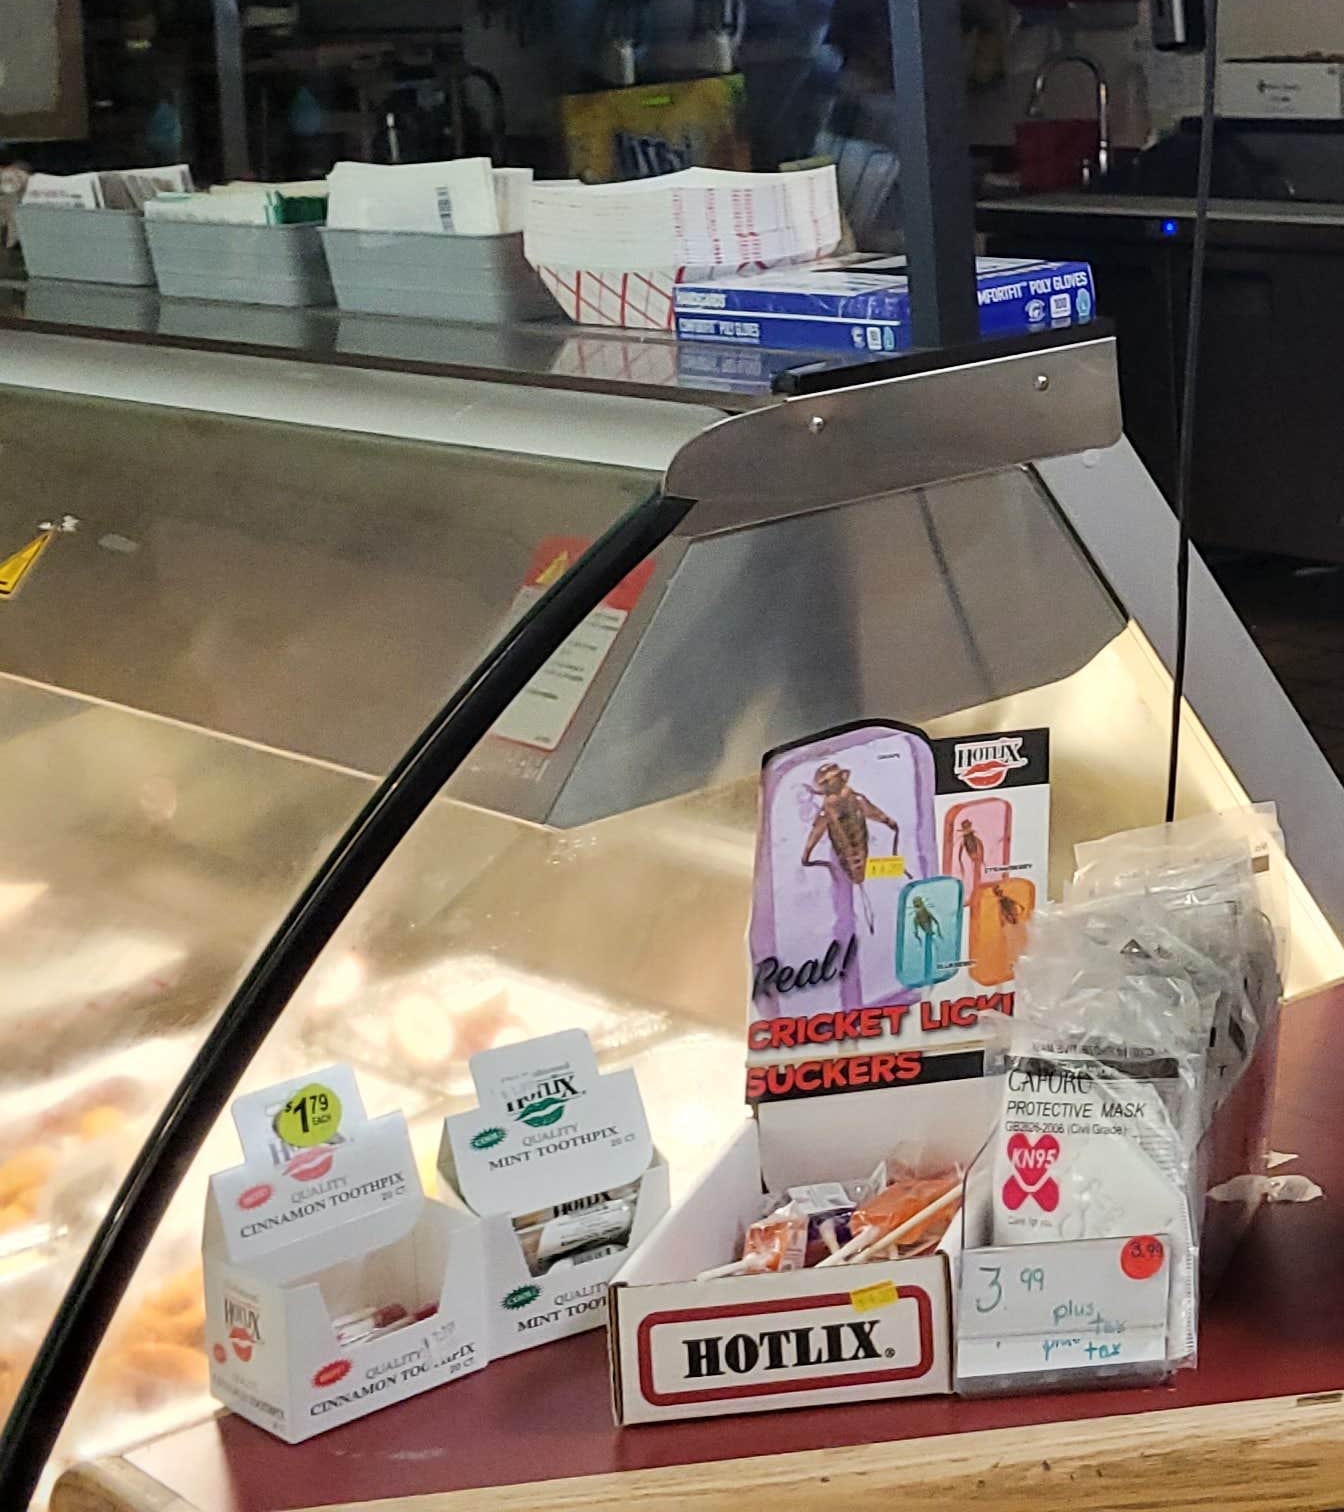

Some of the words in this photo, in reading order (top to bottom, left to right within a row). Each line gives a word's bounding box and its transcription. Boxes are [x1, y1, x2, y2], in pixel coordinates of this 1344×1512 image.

[1029, 277, 1052, 295] POLY
[1053, 271, 1089, 291] GLOVES
[735, 322, 760, 338] GLOVES
[751, 932, 859, 1002] Real!
[747, 1003, 910, 1052] CRICKET
[747, 1050, 923, 1098] SUCKERS
[1006, 1100, 1094, 1119] PROTECTIVE
[1100, 1102, 1147, 1119] MASK
[488, 1150, 532, 1172] MINT
[535, 1124, 620, 1160] TOOTHPIX
[521, 1121, 579, 1148] QUALITY
[1010, 1147, 1058, 1170] KN95
[239, 1198, 327, 1240] CINNAMON
[330, 1170, 406, 1207] TOOTHPIX
[290, 1175, 349, 1205] QUALITY
[516, 1310, 562, 1333] MINT
[1052, 1299, 1096, 1326] plus
[365, 1348, 425, 1381] QUALITY
[683, 1319, 882, 1380] HOTLIX
[309, 1374, 398, 1418] CINNAMON
